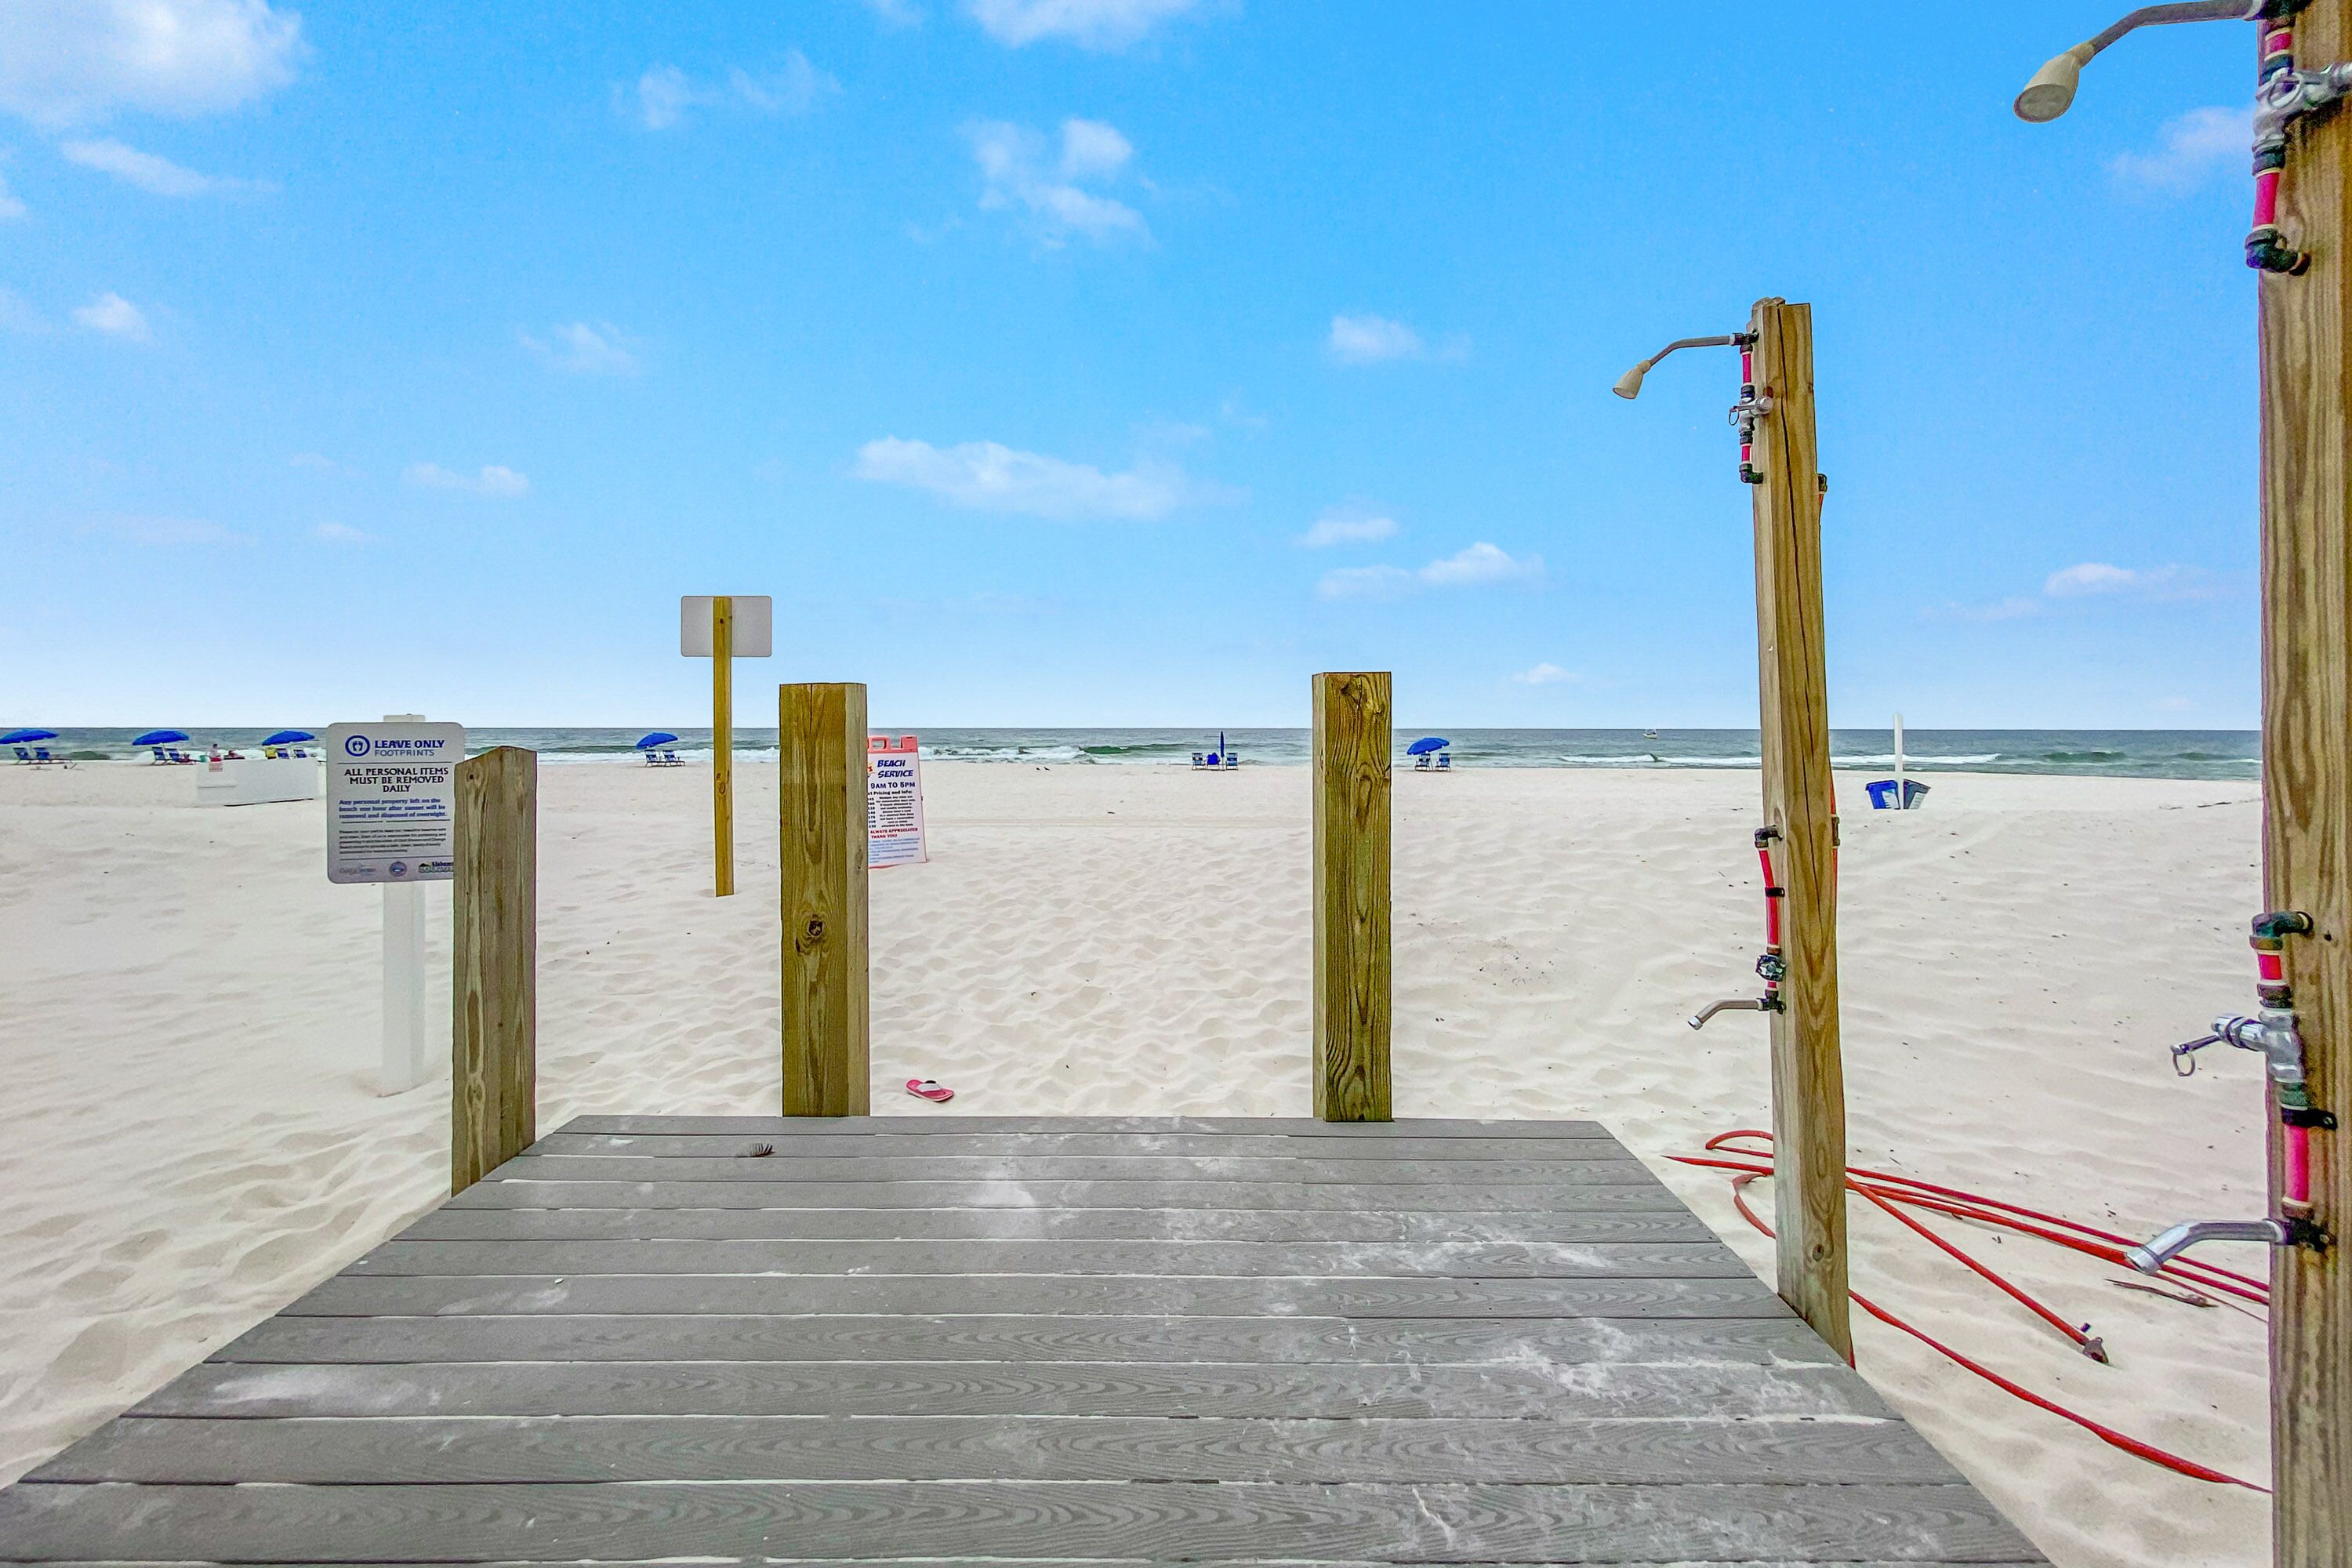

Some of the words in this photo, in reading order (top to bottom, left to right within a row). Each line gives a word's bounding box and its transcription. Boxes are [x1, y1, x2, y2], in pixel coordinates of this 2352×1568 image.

[414, 739, 445, 748] ONLY
[877, 759, 906, 768] BEACH
[877, 769, 913, 779] SERVICE
[350, 776, 379, 785] MUST
